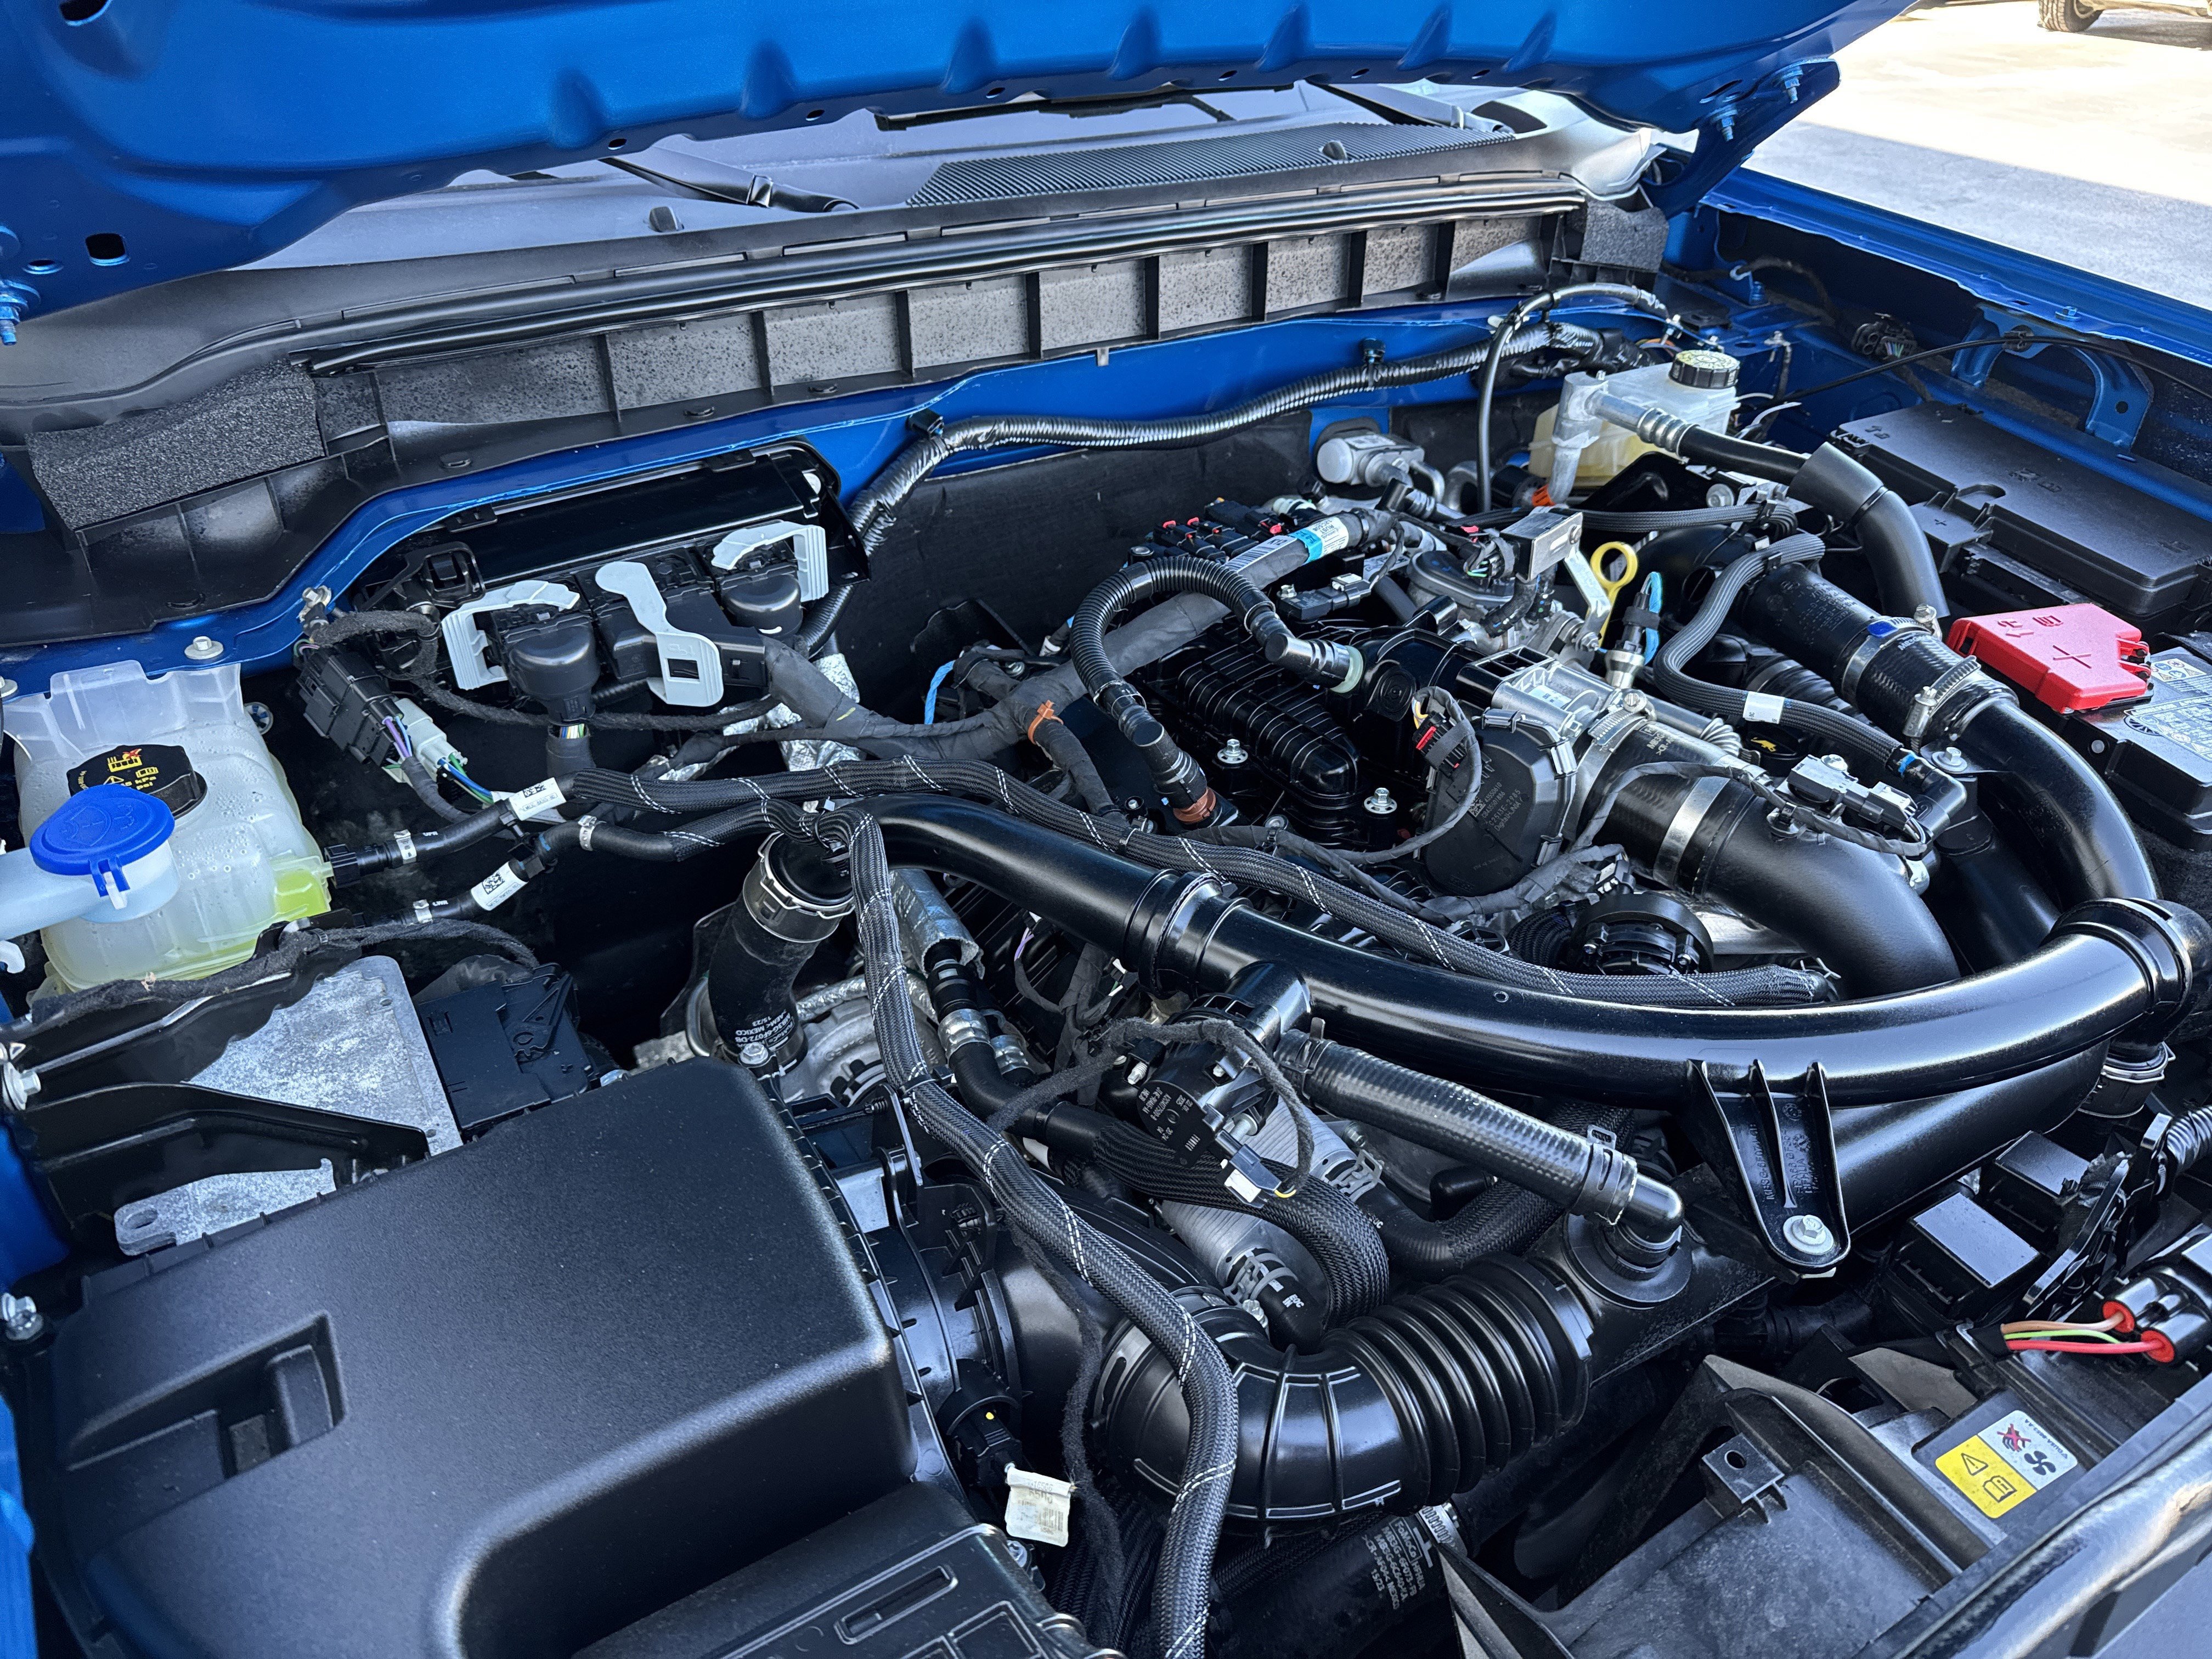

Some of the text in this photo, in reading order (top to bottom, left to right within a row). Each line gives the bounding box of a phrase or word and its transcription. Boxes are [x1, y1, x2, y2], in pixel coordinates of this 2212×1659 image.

[735, 1025, 765, 1036] MEXICO
[1289, 1294, 1305, 1308] EOC
[1395, 1520, 1417, 1558] FoMoCo
